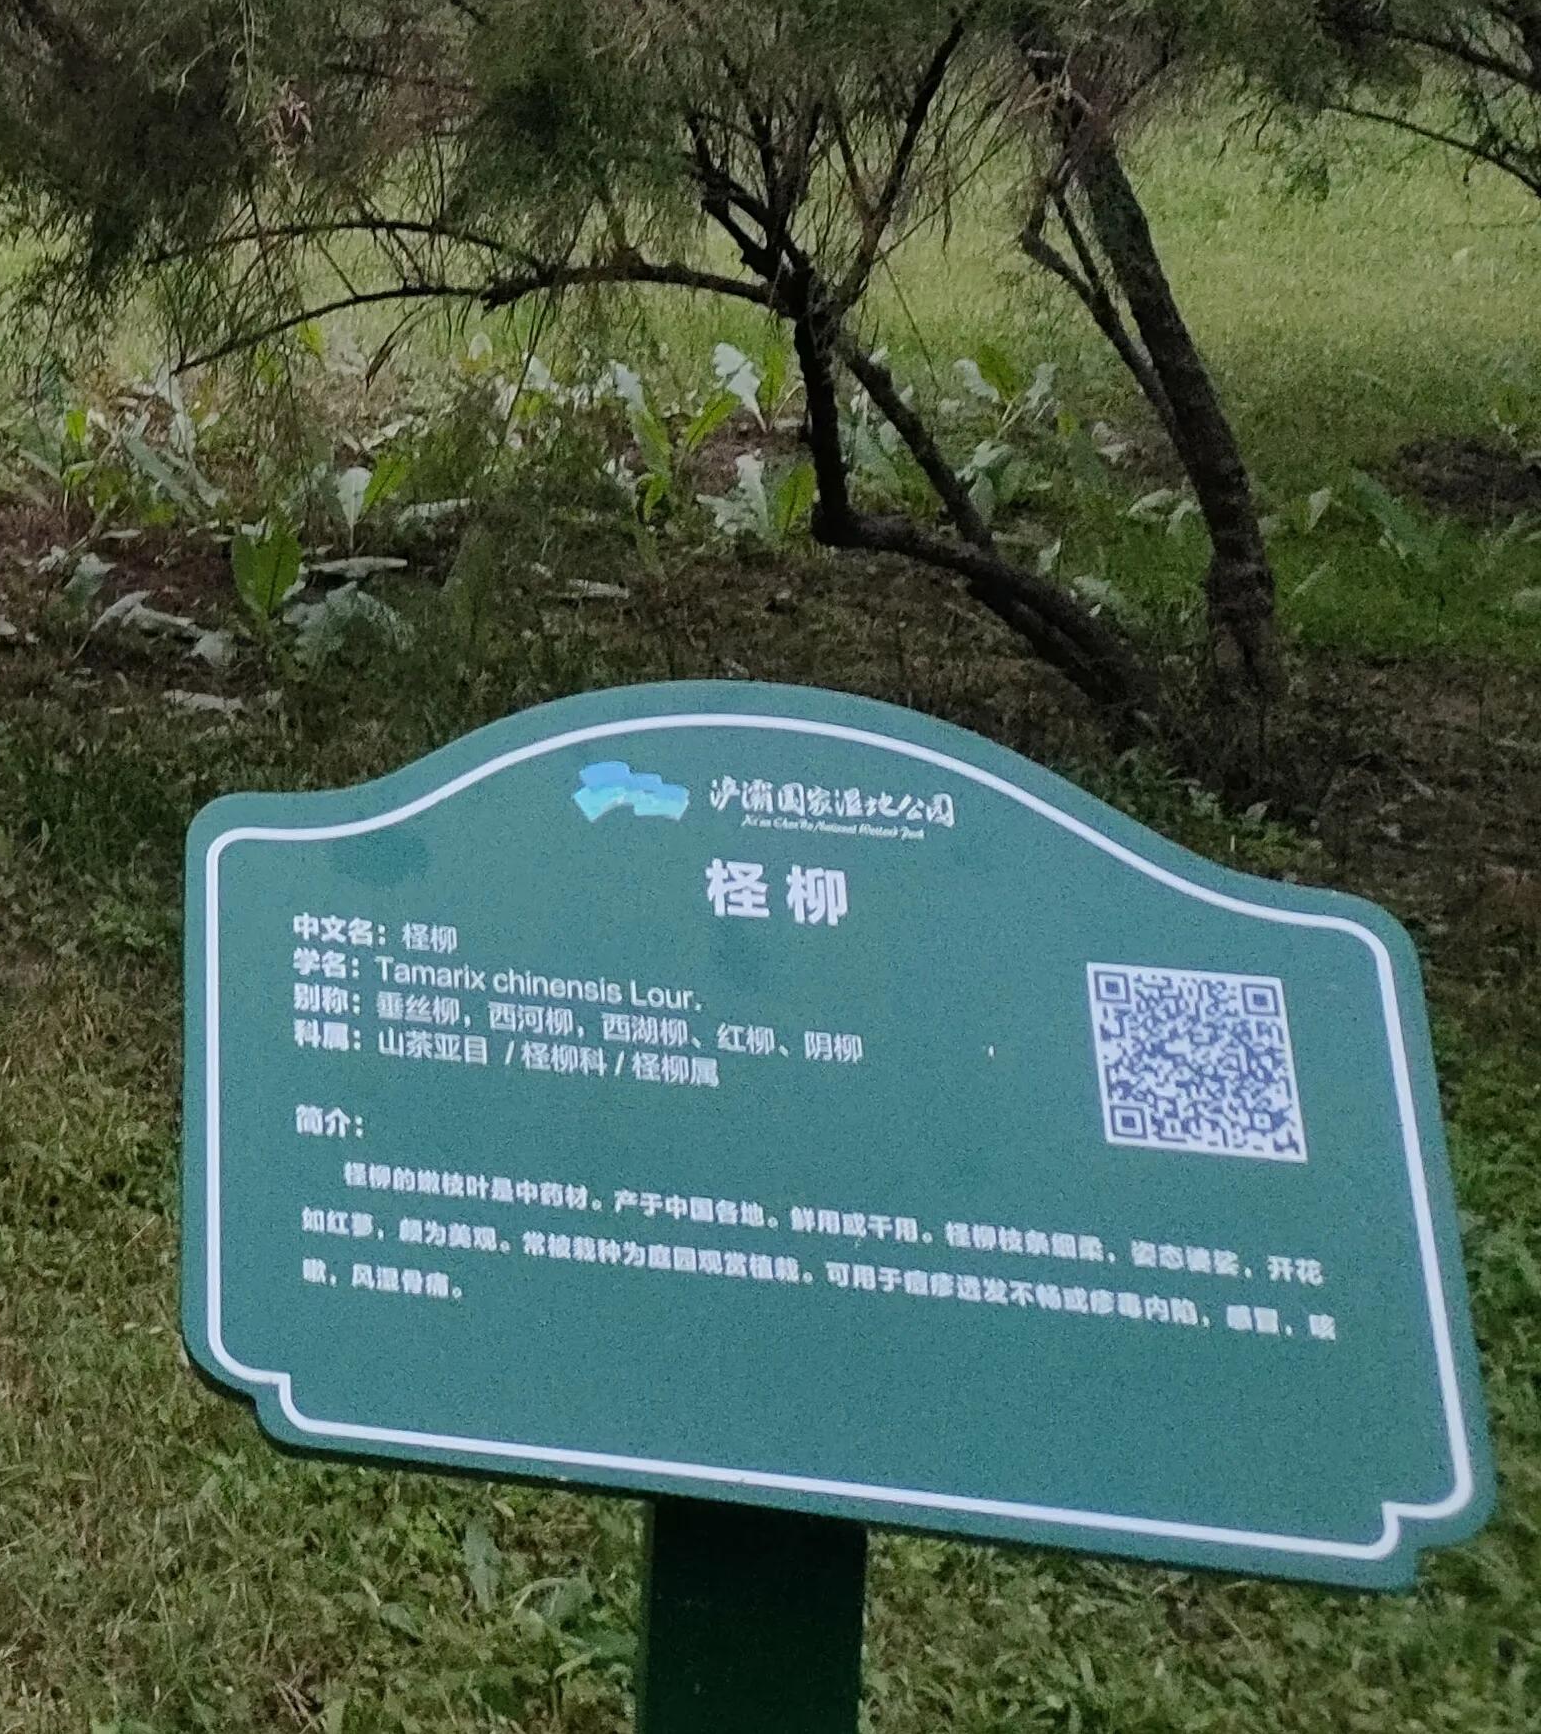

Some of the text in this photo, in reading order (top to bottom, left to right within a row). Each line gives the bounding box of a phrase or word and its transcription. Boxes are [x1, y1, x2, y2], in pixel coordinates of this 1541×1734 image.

[710, 774, 955, 828] 浐灞国家湿地公园
[705, 858, 848, 926] 柽柳
[374, 955, 486, 992] Tamarix
[492, 968, 623, 1004] chinensis
[630, 979, 703, 1012] Lour.
